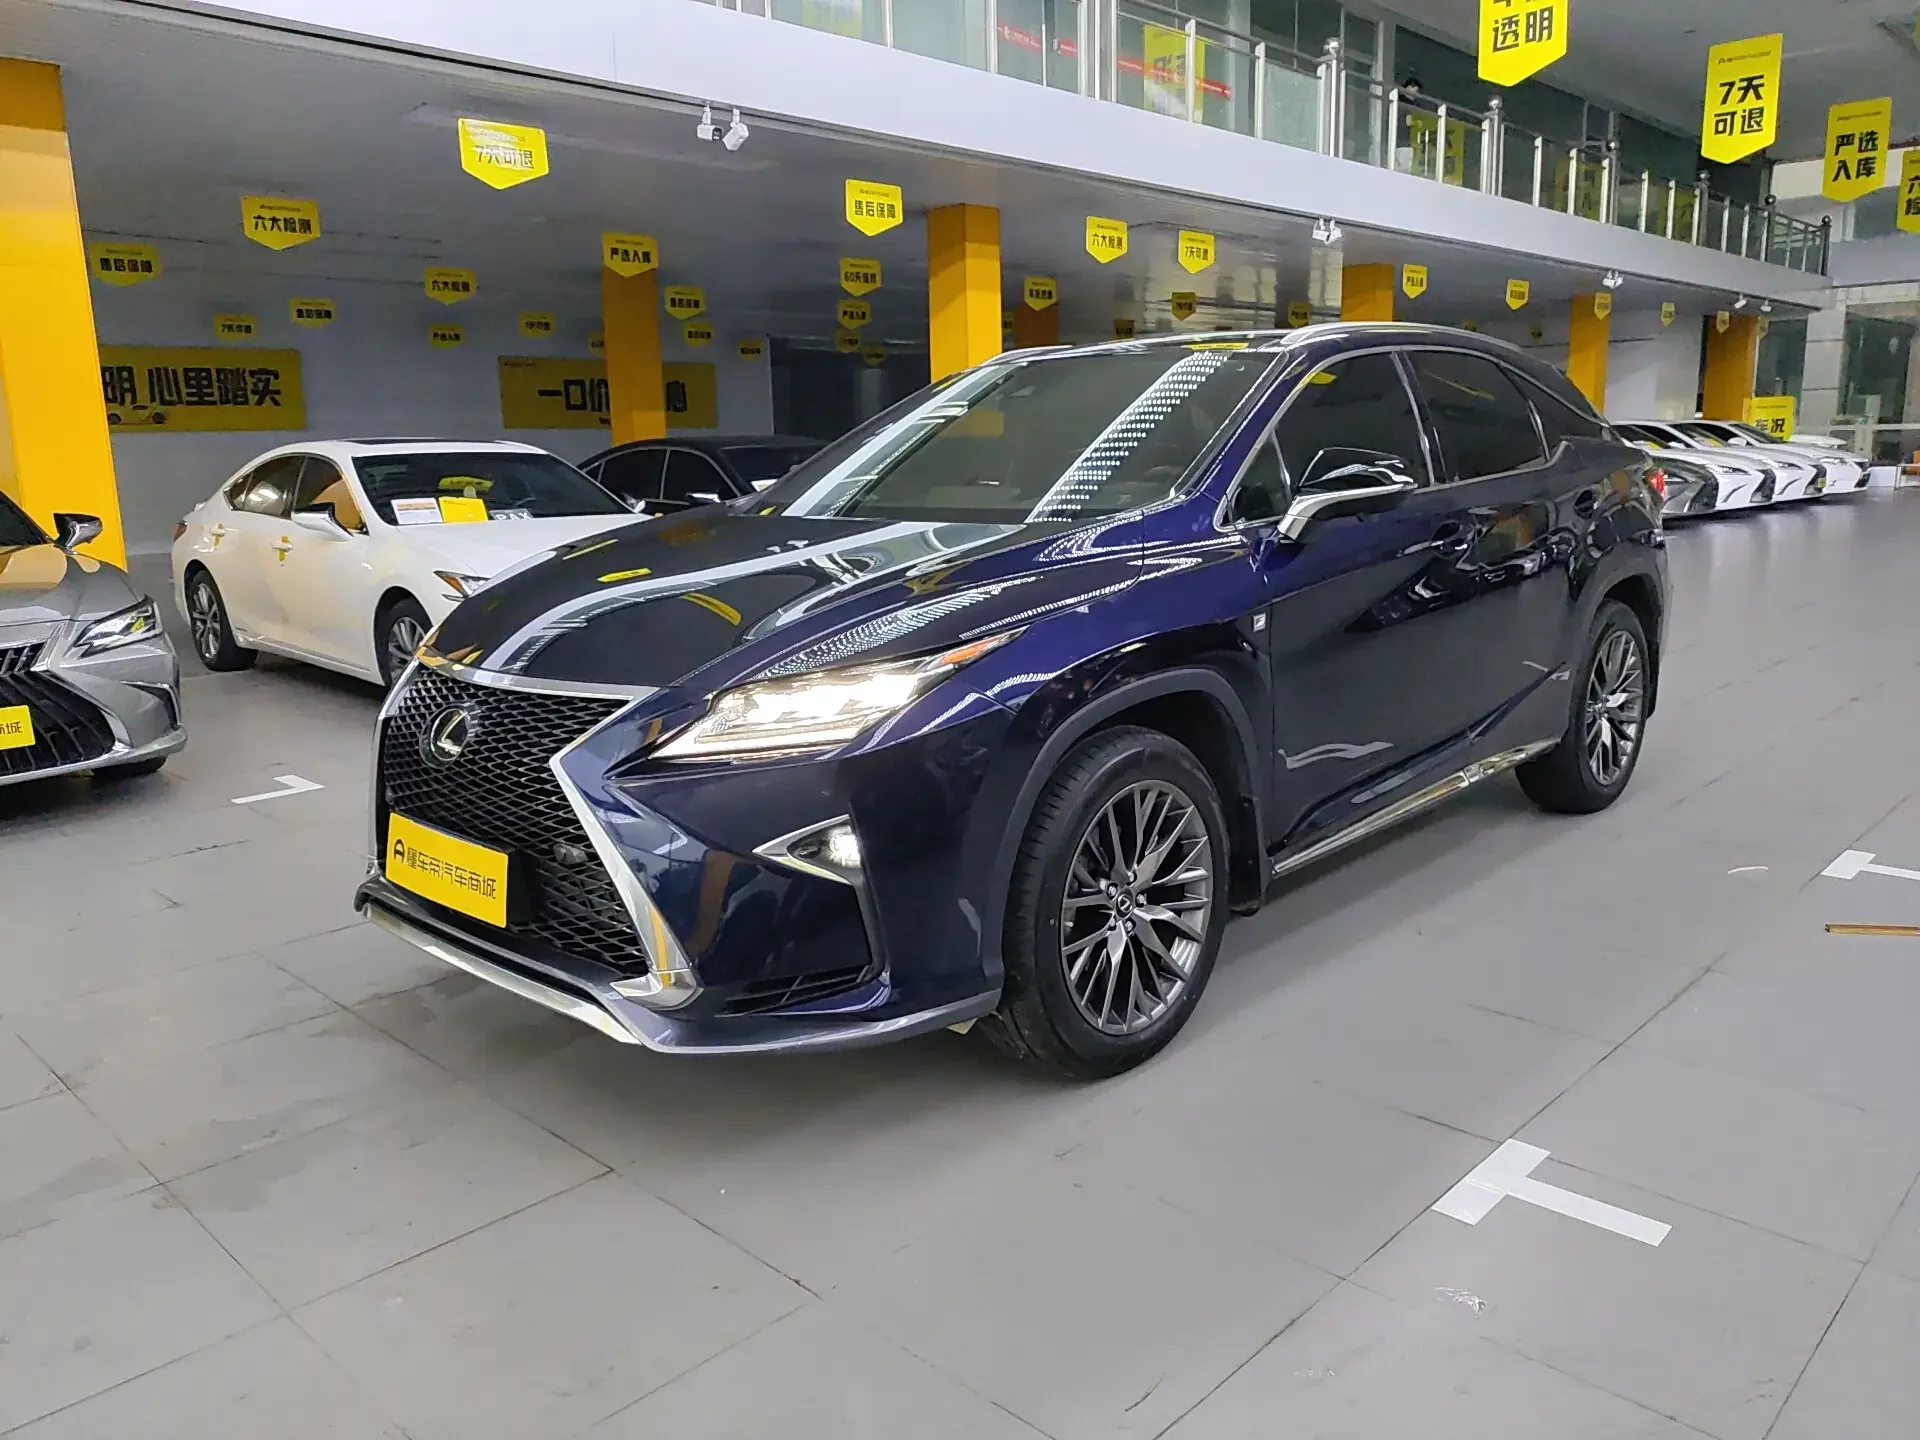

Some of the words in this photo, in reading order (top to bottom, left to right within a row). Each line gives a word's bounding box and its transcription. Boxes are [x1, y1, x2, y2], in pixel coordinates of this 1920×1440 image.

[1492, 5, 1554, 53] 透明
[1718, 74, 1765, 106] 7天
[1713, 106, 1765, 136] 可退
[1834, 130, 1880, 156] 严选
[475, 143, 535, 170] 7天可退
[1831, 156, 1877, 182] 入库
[854, 199, 897, 220] 售后保障
[251, 214, 312, 235] 六大检测
[1092, 232, 1124, 251] 六大检测
[609, 247, 652, 266] 严选入库
[1184, 246, 1209, 261] 7天可退
[99, 257, 154, 274] 售后保障
[147, 366, 282, 407] 心里踏实
[1755, 417, 1786, 434] 车况
